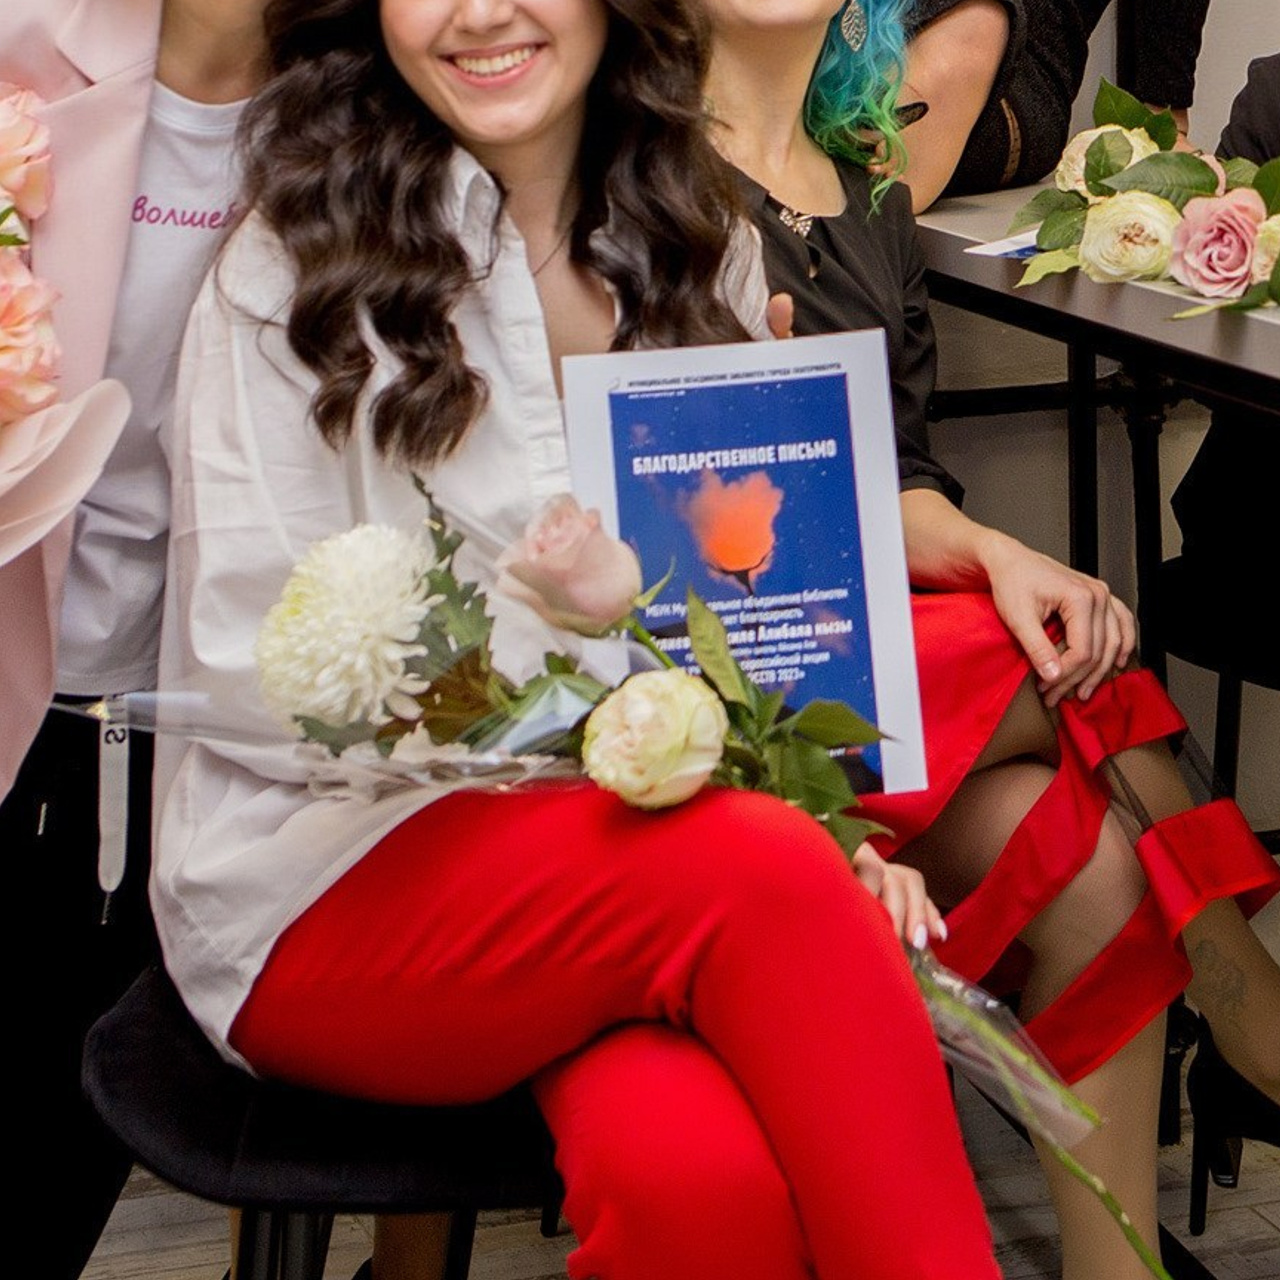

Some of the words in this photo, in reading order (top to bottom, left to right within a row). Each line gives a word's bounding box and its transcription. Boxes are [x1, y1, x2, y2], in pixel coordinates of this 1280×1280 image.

[632, 445, 776, 475] БЛАГОДАРСТВЕННОЕ
[778, 439, 838, 462] ПИСЬМО
[757, 622, 813, 642] Алибала
[814, 619, 853, 636] кызы
